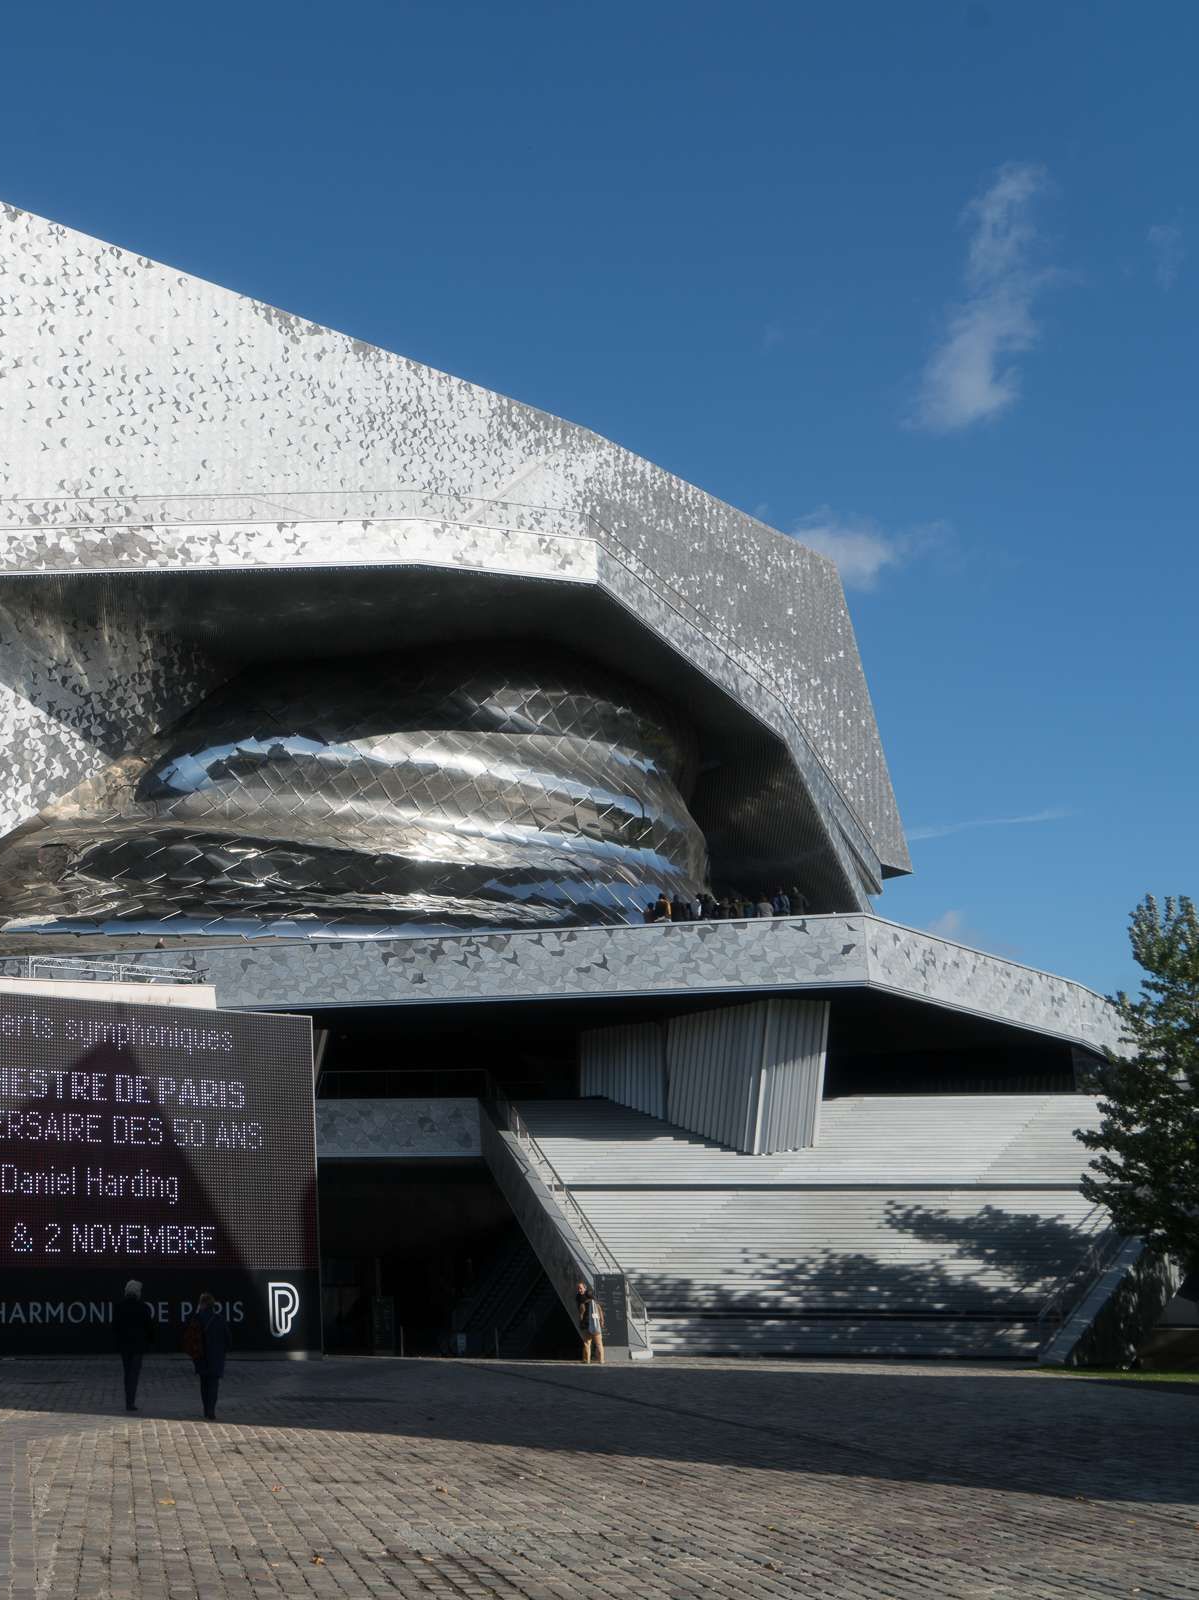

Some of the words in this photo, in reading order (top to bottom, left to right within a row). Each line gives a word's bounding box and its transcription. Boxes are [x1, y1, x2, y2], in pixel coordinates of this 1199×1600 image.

[65, 1017, 233, 1055] symphoniques
[115, 1074, 151, 1104] DE
[158, 1076, 245, 1109] PARIS
[113, 1115, 163, 1145] DES
[173, 1118, 205, 1147] 50
[215, 1121, 263, 1149] ANS
[1, 1164, 76, 1195] Daniel
[87, 1167, 178, 1205] Harding
[10, 1222, 33, 1252] &
[44, 1223, 61, 1253] 2
[72, 1223, 216, 1255] NOVEMBRE
[180, 1301, 244, 1323] PIS
